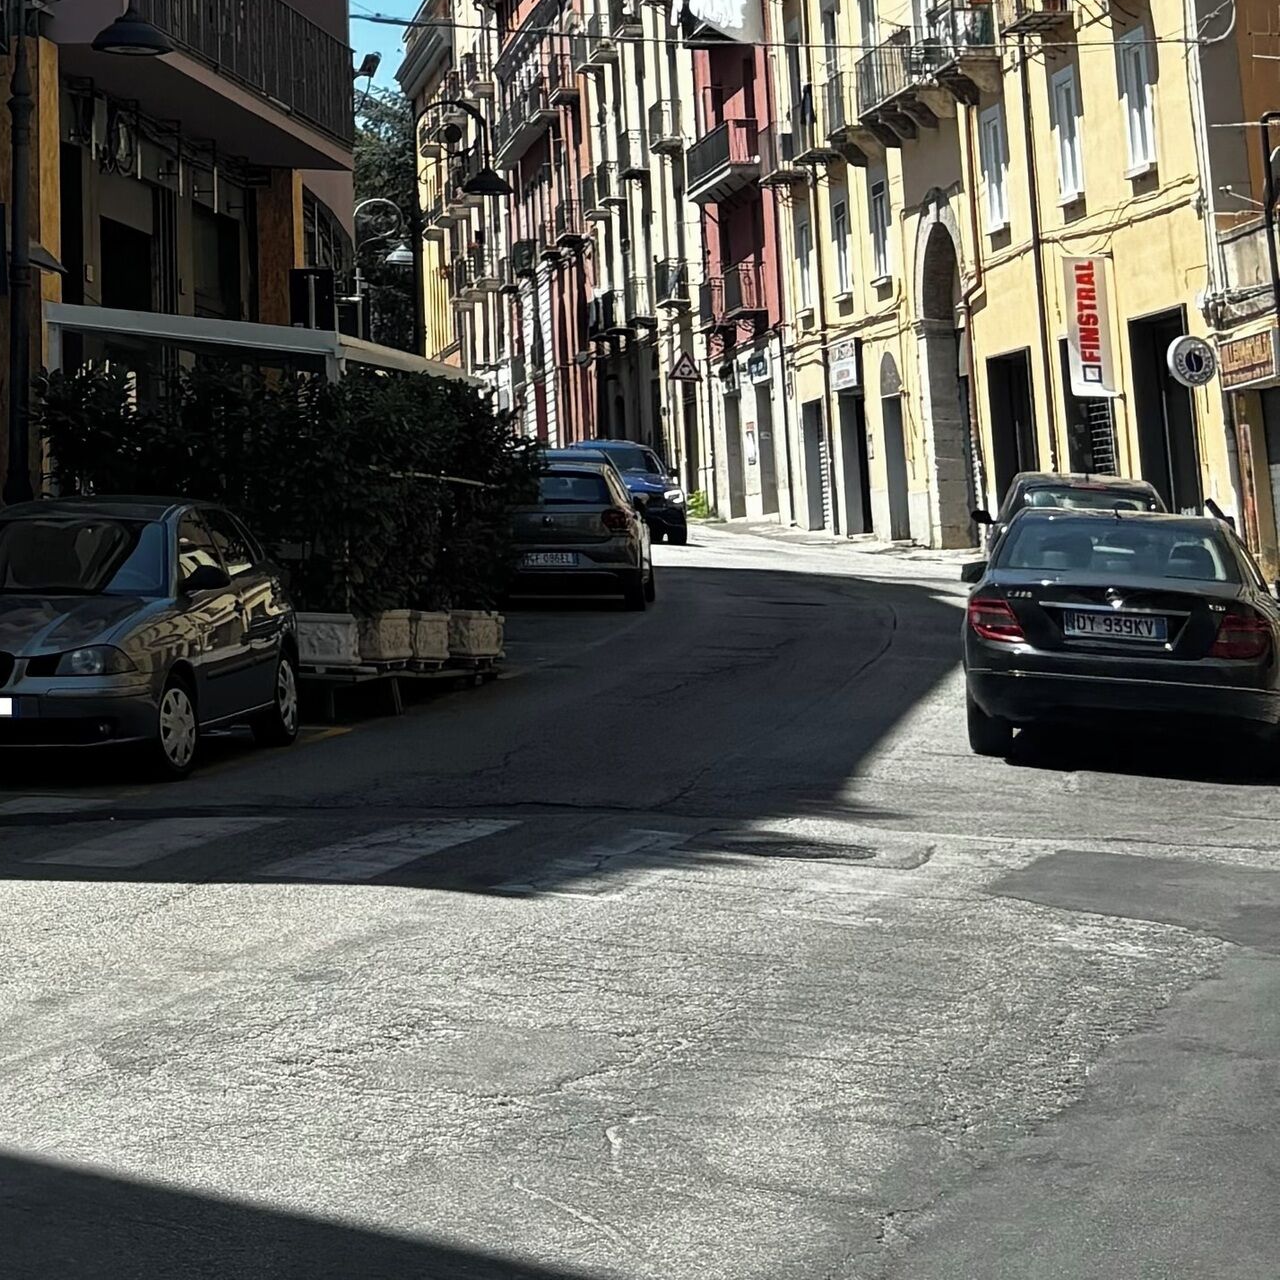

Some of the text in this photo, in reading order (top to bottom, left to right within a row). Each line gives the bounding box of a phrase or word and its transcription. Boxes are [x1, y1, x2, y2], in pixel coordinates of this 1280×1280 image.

[1074, 259, 1102, 363] FINSTRAL
[1075, 614, 1155, 636] DY 939KV
